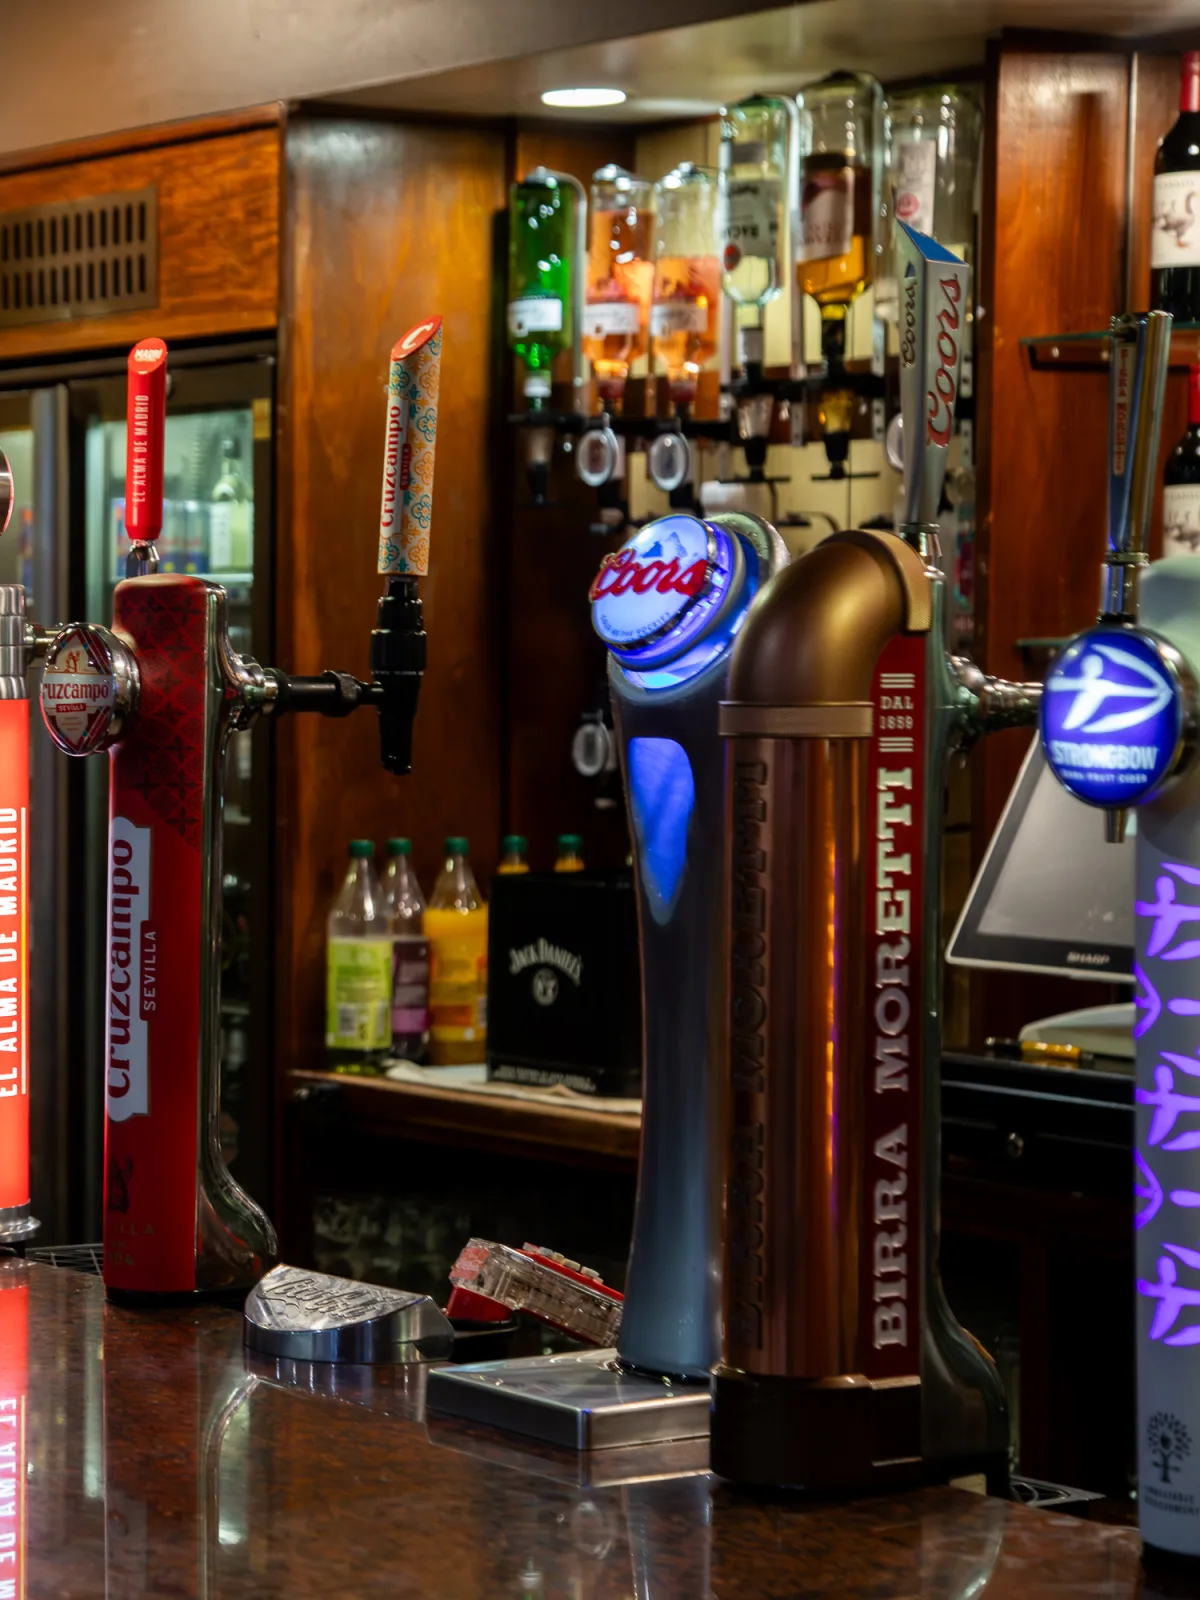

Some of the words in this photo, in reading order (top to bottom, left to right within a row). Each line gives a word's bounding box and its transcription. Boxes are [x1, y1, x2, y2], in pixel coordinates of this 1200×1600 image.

[903, 281, 917, 368] Coors
[927, 273, 962, 448] Coors
[134, 395, 149, 436] MADRID
[134, 440, 148, 453] DE
[381, 405, 402, 527] Cruzcampo
[133, 458, 147, 486] ALMA
[132, 489, 146, 503] EL
[588, 548, 709, 602] Coors
[880, 696, 914, 709] DAL
[880, 716, 913, 729] 1859
[1052, 740, 1158, 769] STRONGBOW
[875, 767, 913, 1094] MORETTI
[107, 840, 140, 1098] Cruzcampo
[143, 930, 157, 1011] SEVILLA
[509, 942, 539, 975] JACK
[873, 1122, 908, 1350] BIRRA
